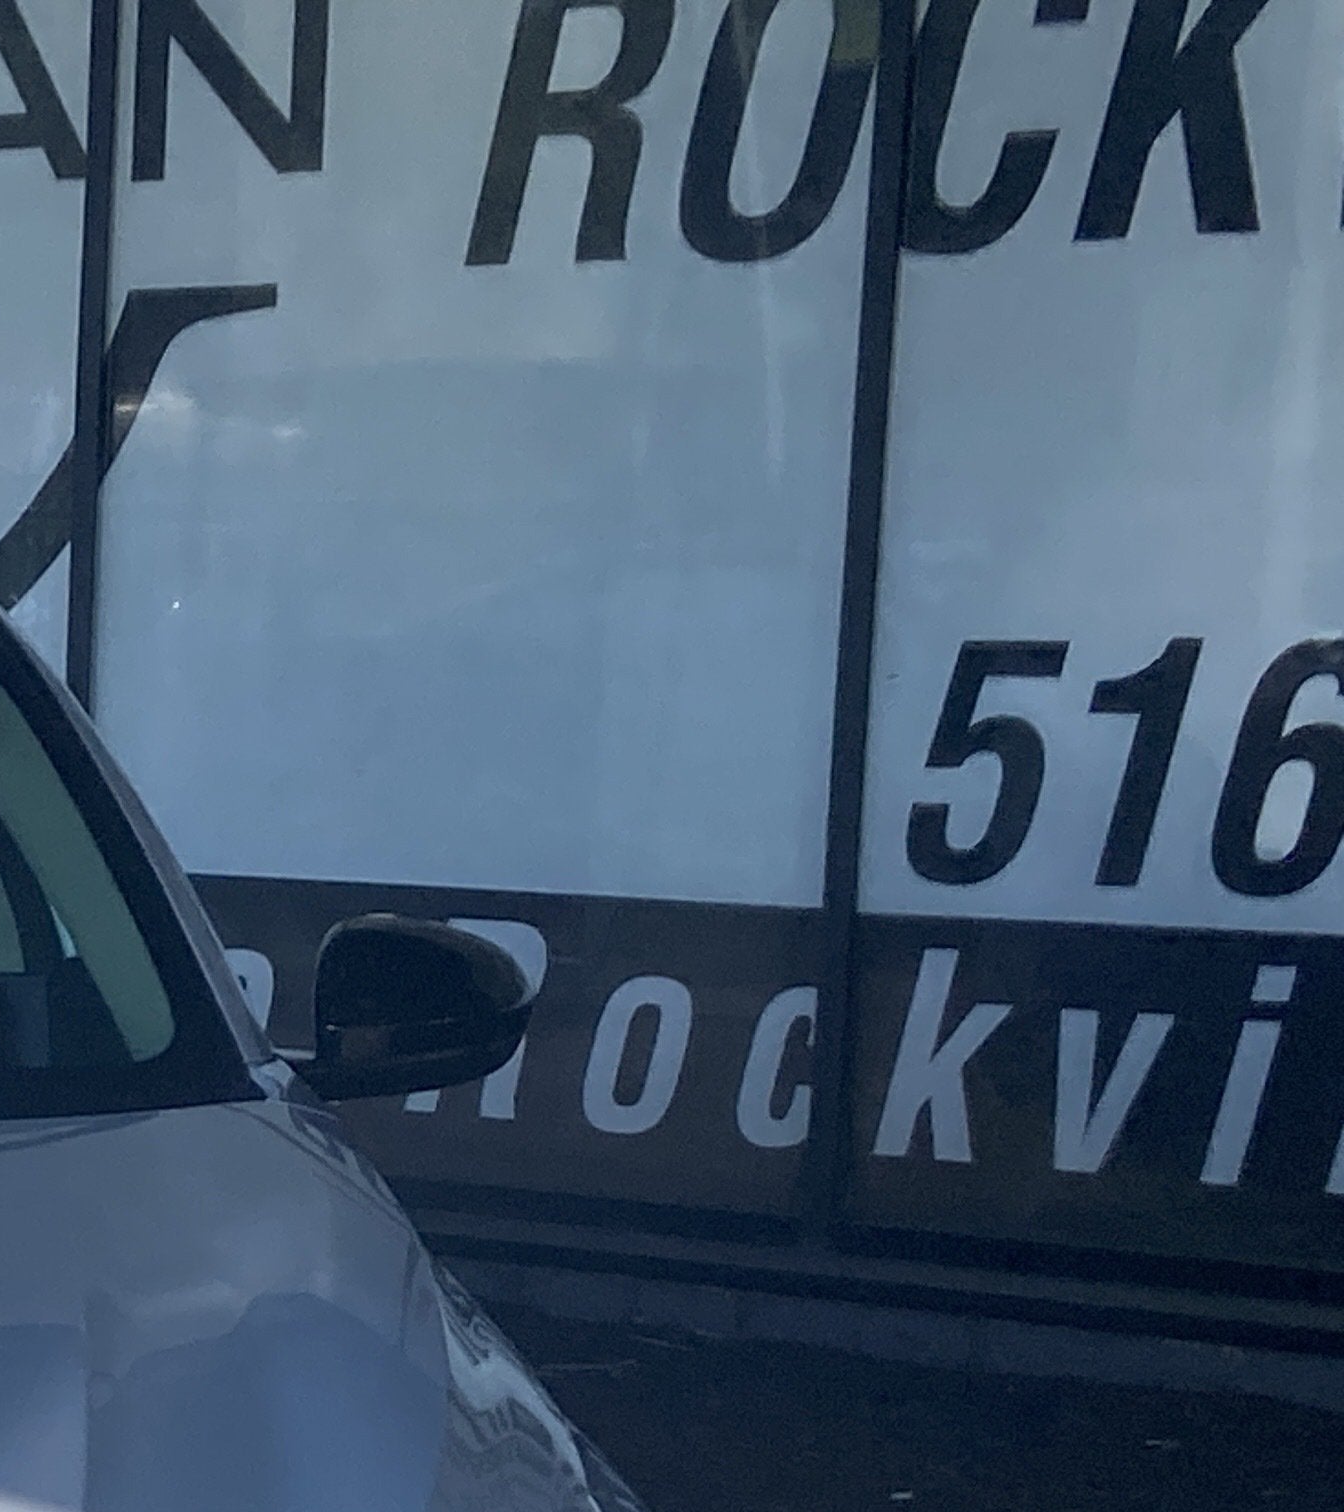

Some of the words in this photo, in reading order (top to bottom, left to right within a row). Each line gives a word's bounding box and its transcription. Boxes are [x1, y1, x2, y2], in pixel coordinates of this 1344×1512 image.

[465, 0, 1344, 266] ROCK
[905, 636, 1344, 898] 516
[404, 917, 1344, 1195] ockvi
